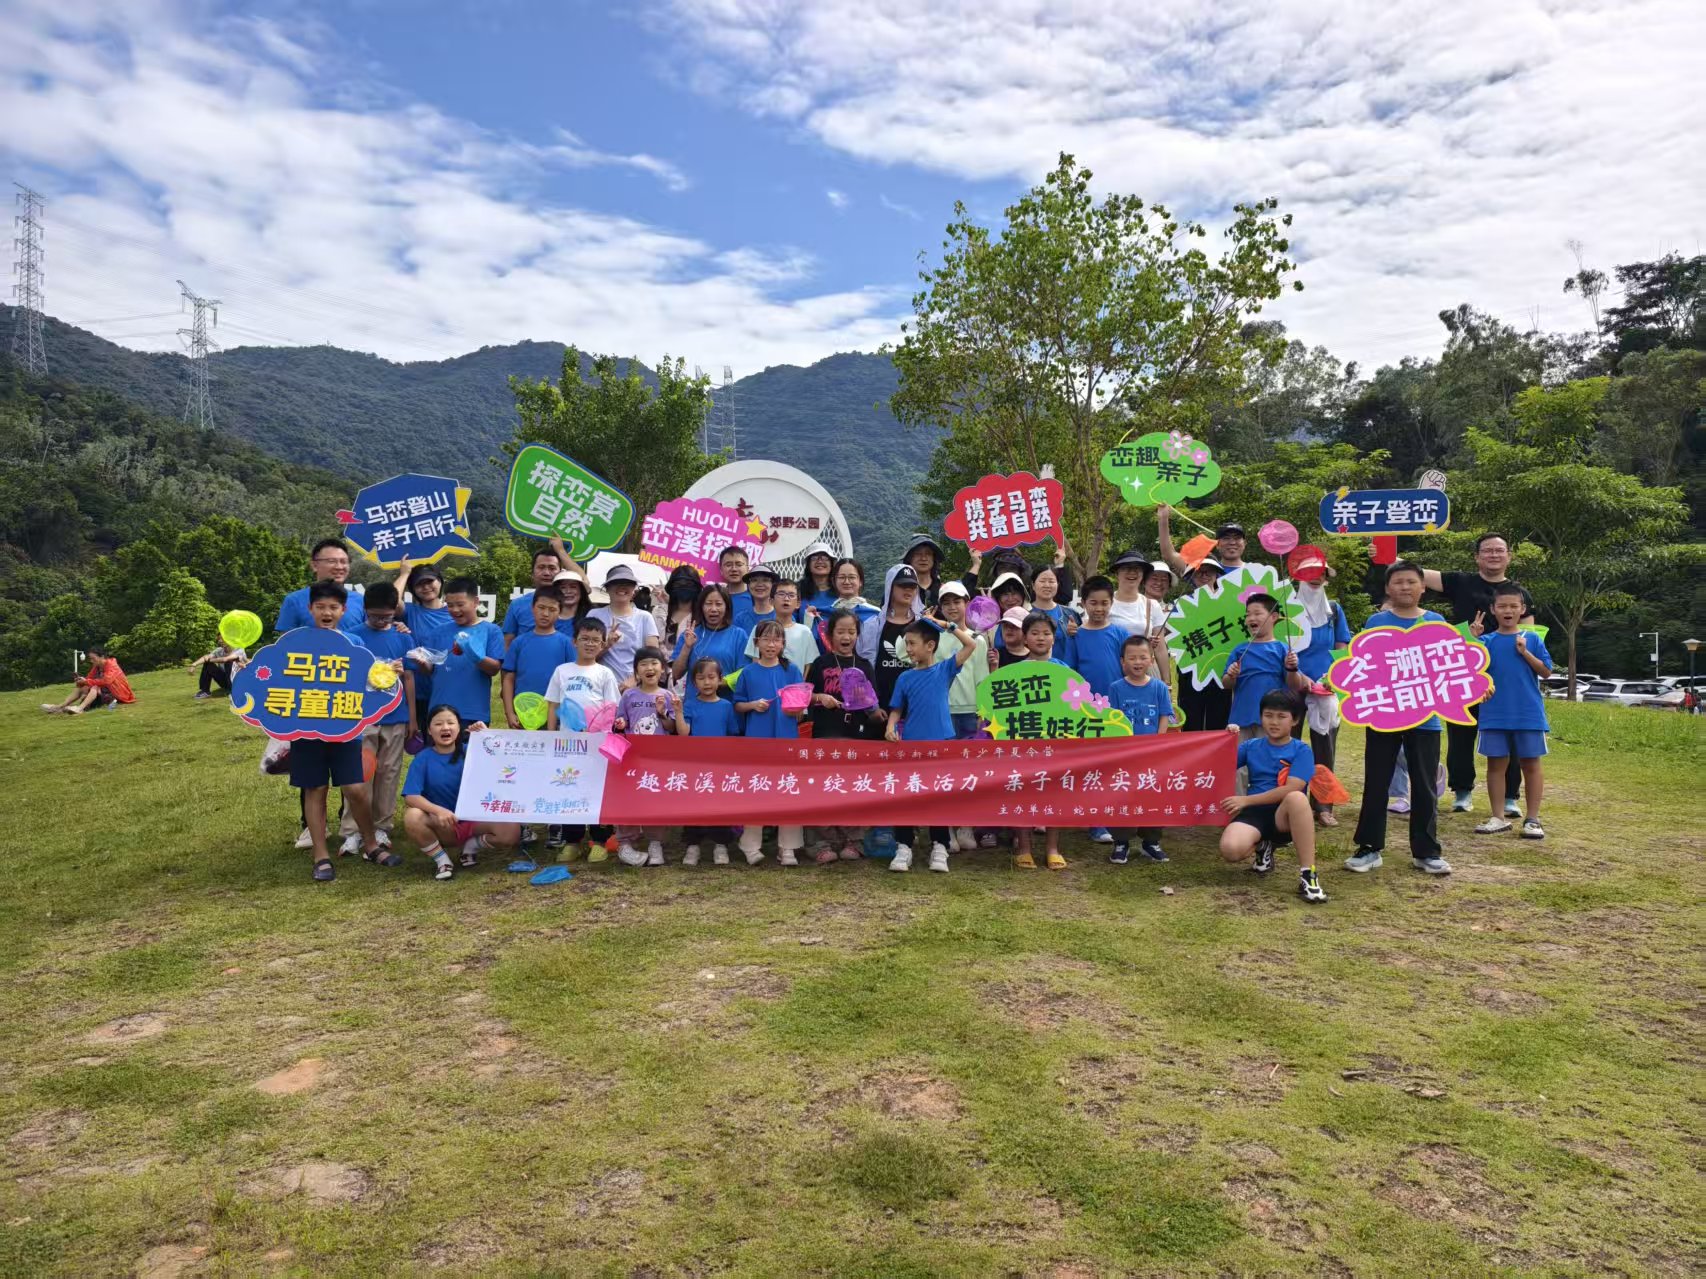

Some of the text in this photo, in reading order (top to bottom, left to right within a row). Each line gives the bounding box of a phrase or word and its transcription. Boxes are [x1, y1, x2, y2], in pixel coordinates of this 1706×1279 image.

[1110, 446, 1160, 467] 峦趣
[1156, 461, 1208, 486] 亲子
[365, 491, 450, 524] 马峦登山
[527, 460, 621, 525] 探峦赏
[965, 487, 1047, 521] 携子马峦
[530, 493, 594, 541] 自然
[682, 506, 740, 533] HUOLI
[769, 516, 820, 530] 郊野公园
[969, 507, 1053, 542] 共赏自然
[1332, 499, 1438, 525] 亲子登峦
[373, 514, 455, 550] 亲子同行
[283, 652, 350, 683] 马峦
[882, 659, 910, 668] adida
[1384, 637, 1466, 681] 溯峦
[264, 687, 364, 719] 寻童趣
[991, 674, 1051, 709] 登峦
[1354, 669, 1474, 719] 共前行
[1006, 711, 1105, 740] 携娃行
